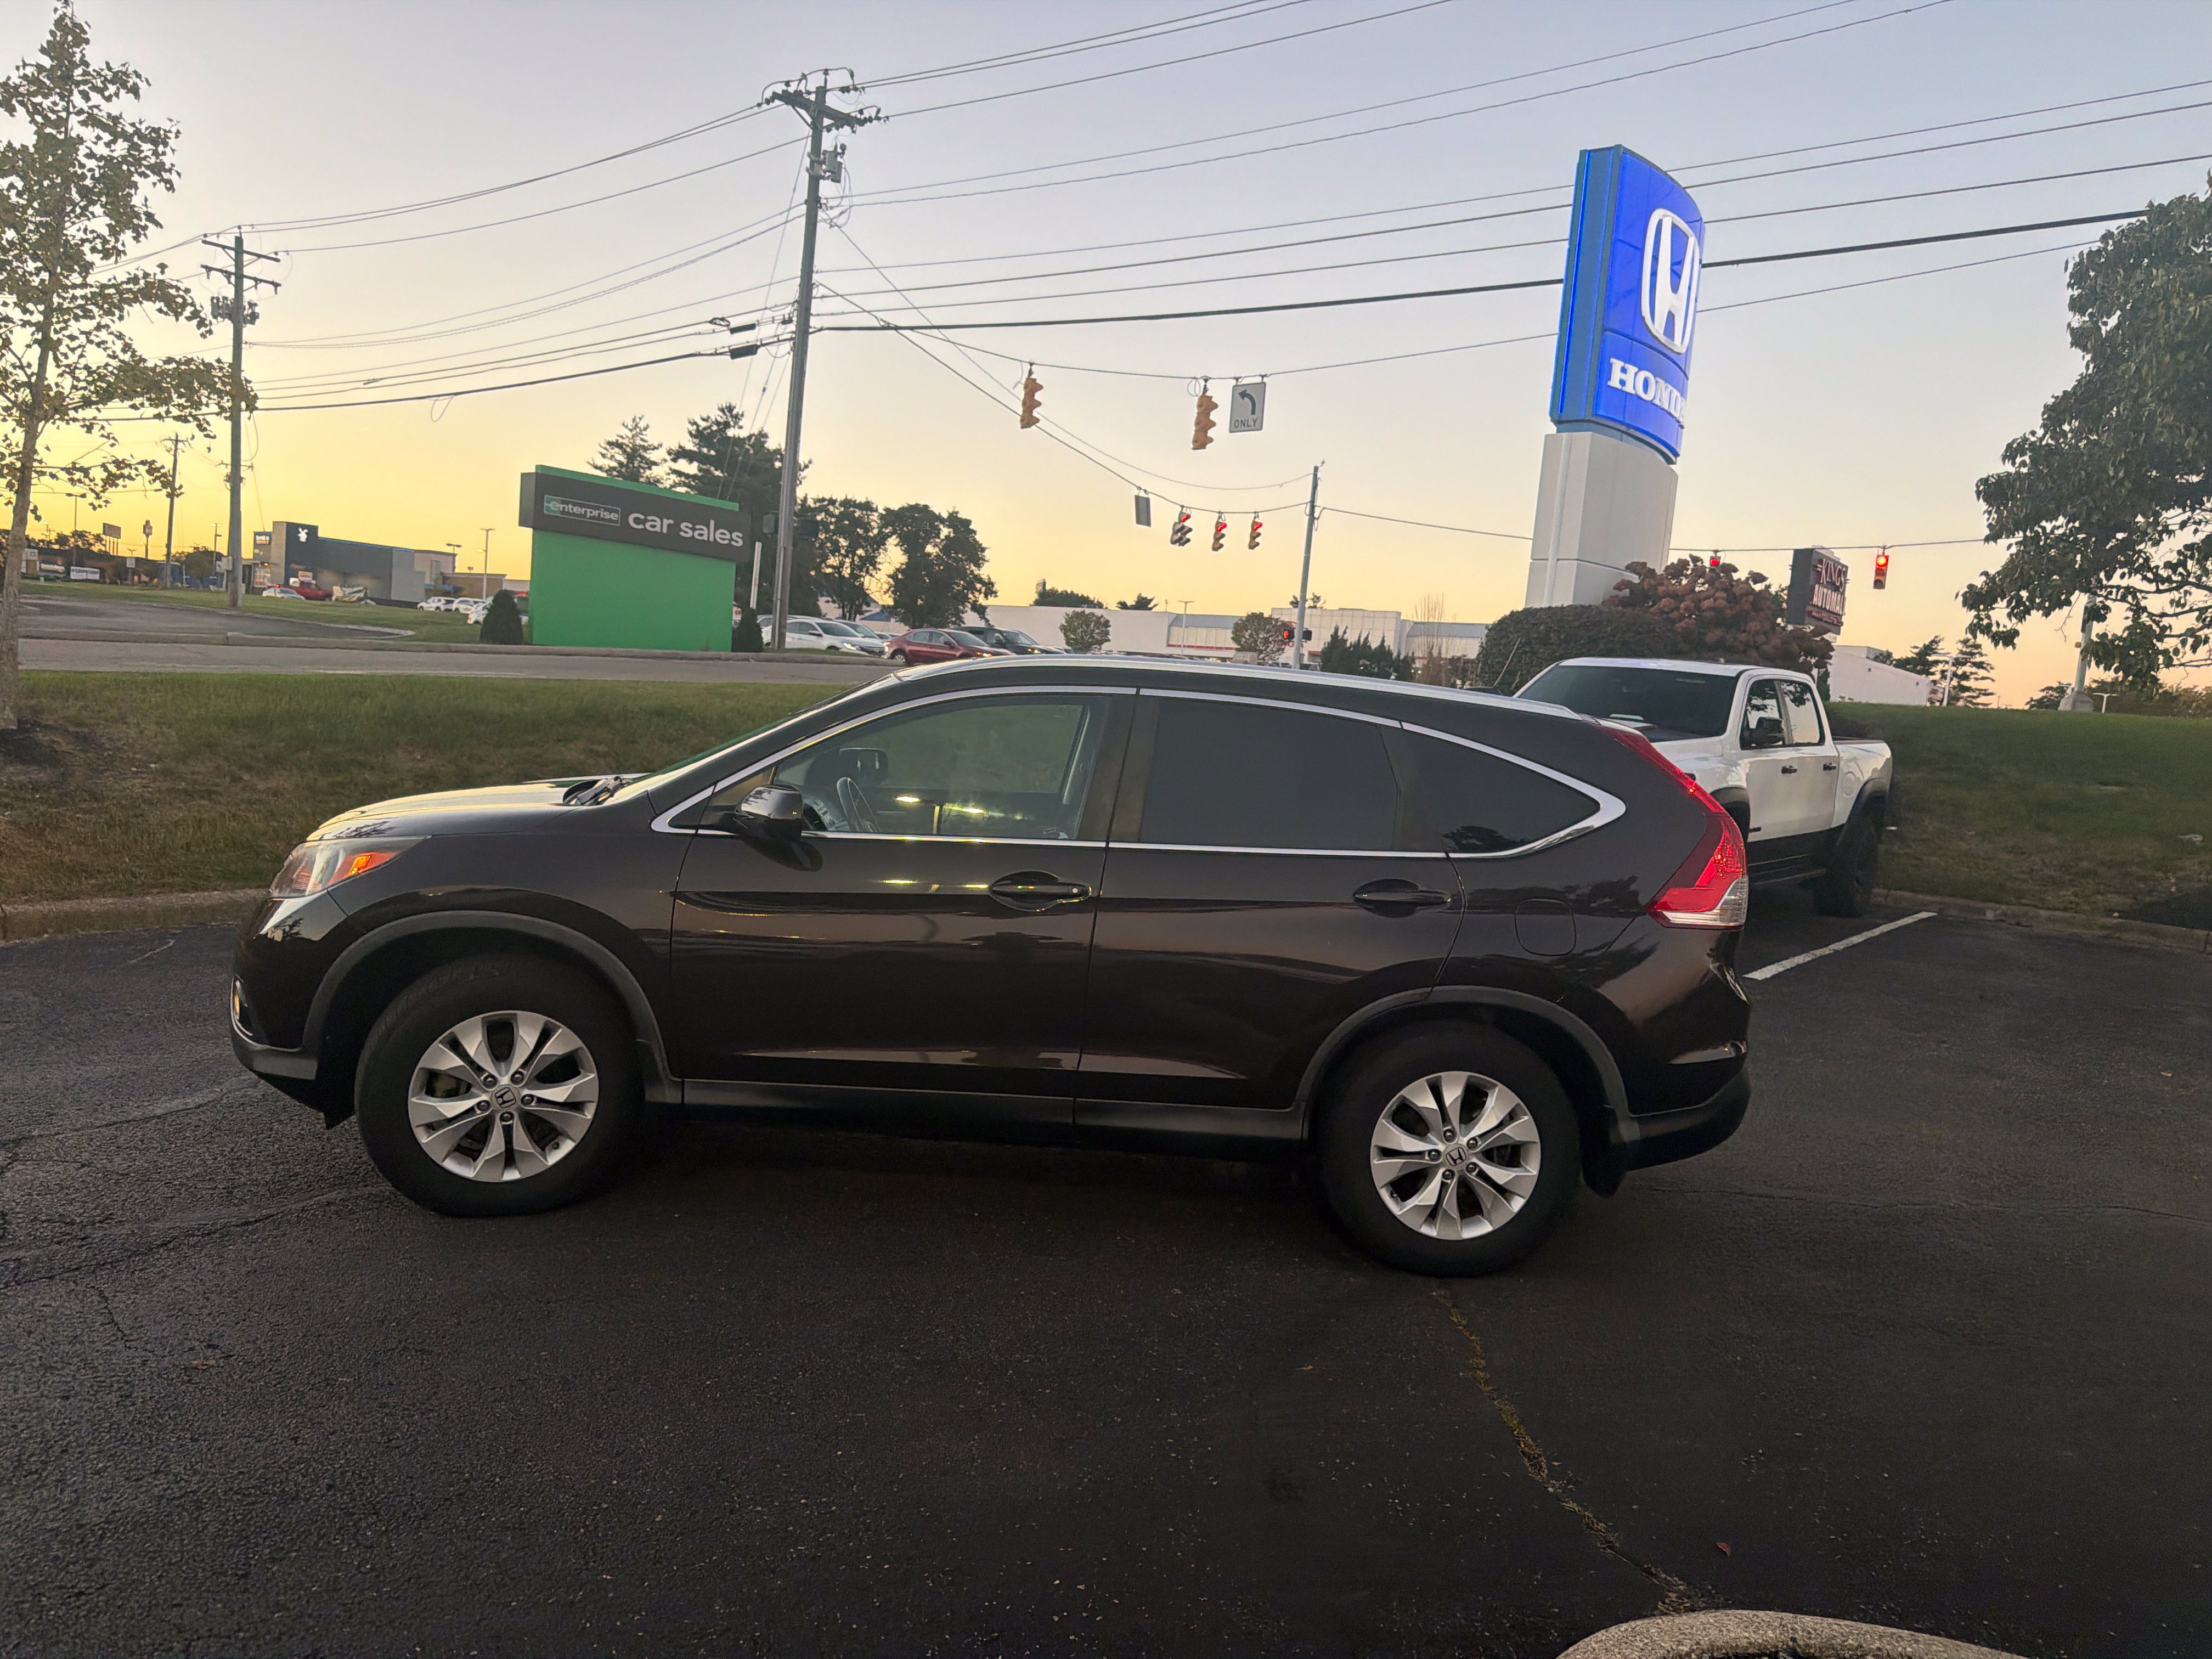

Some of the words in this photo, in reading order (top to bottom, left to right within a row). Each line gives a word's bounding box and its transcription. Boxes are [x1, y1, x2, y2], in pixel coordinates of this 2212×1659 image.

[1234, 418, 1259, 428] ONLY
[549, 500, 619, 521] enterprise
[628, 513, 674, 534] car
[679, 520, 744, 547] sales
